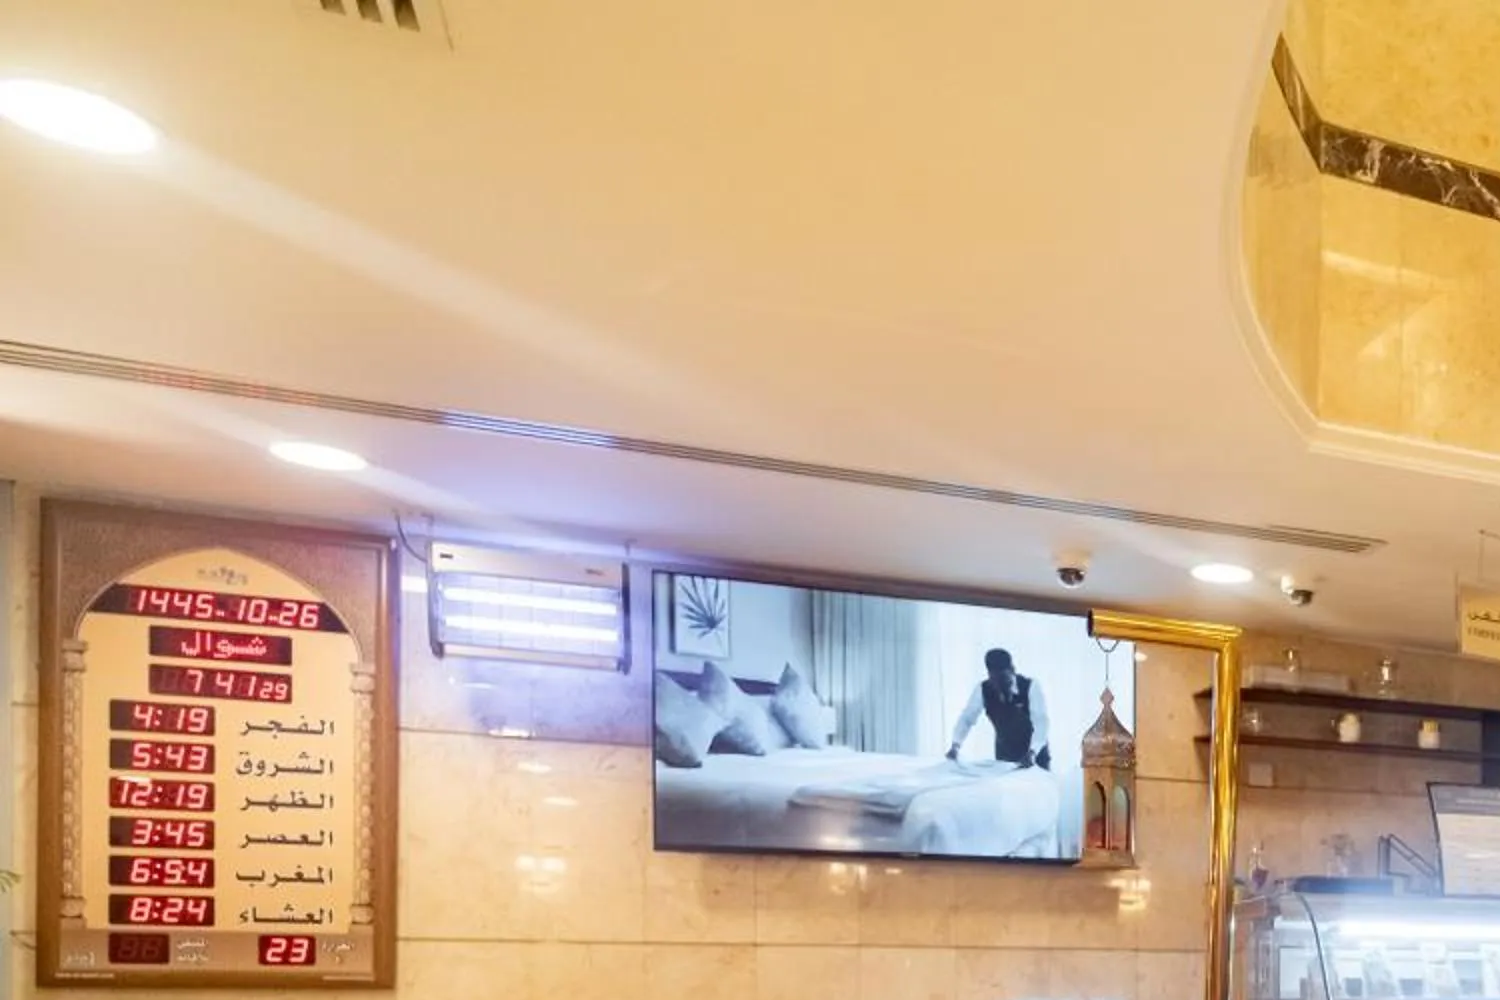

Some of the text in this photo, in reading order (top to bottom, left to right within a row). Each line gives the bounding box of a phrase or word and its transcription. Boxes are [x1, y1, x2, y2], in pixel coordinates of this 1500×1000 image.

[181, 631, 266, 658] شوال
[134, 704, 208, 732] 4:19
[240, 715, 335, 739] الفجر
[132, 743, 208, 770] 5:43
[235, 751, 334, 776] الشروق
[120, 780, 208, 808] 12:19
[240, 790, 334, 812] الظهر
[132, 820, 206, 847] 3:45
[239, 829, 333, 849] العصر
[130, 858, 207, 885] 6:54
[235, 864, 333, 888] المغرب
[130, 897, 207, 923] 8:24
[239, 903, 333, 925] العشاء
[266, 937, 309, 963] 23
